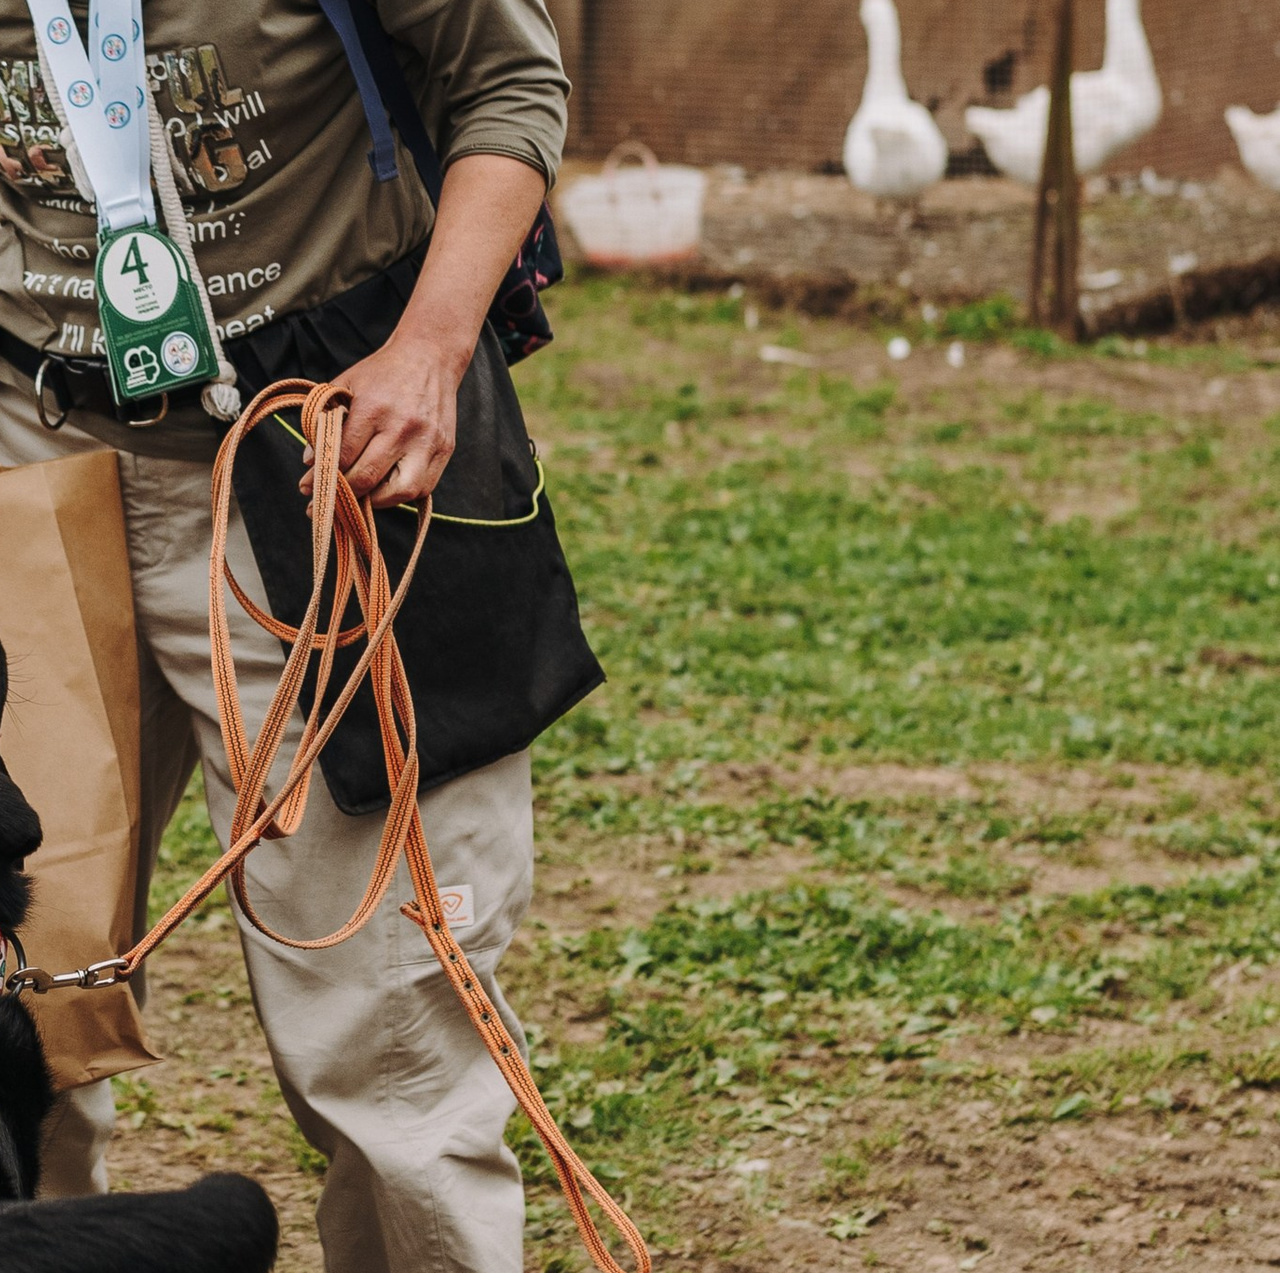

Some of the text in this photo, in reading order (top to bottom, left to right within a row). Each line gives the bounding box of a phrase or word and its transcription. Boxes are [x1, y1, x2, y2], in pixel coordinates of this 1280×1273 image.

[213, 90, 266, 129] will
[120, 236, 150, 285] 4
[207, 262, 282, 296] ance
